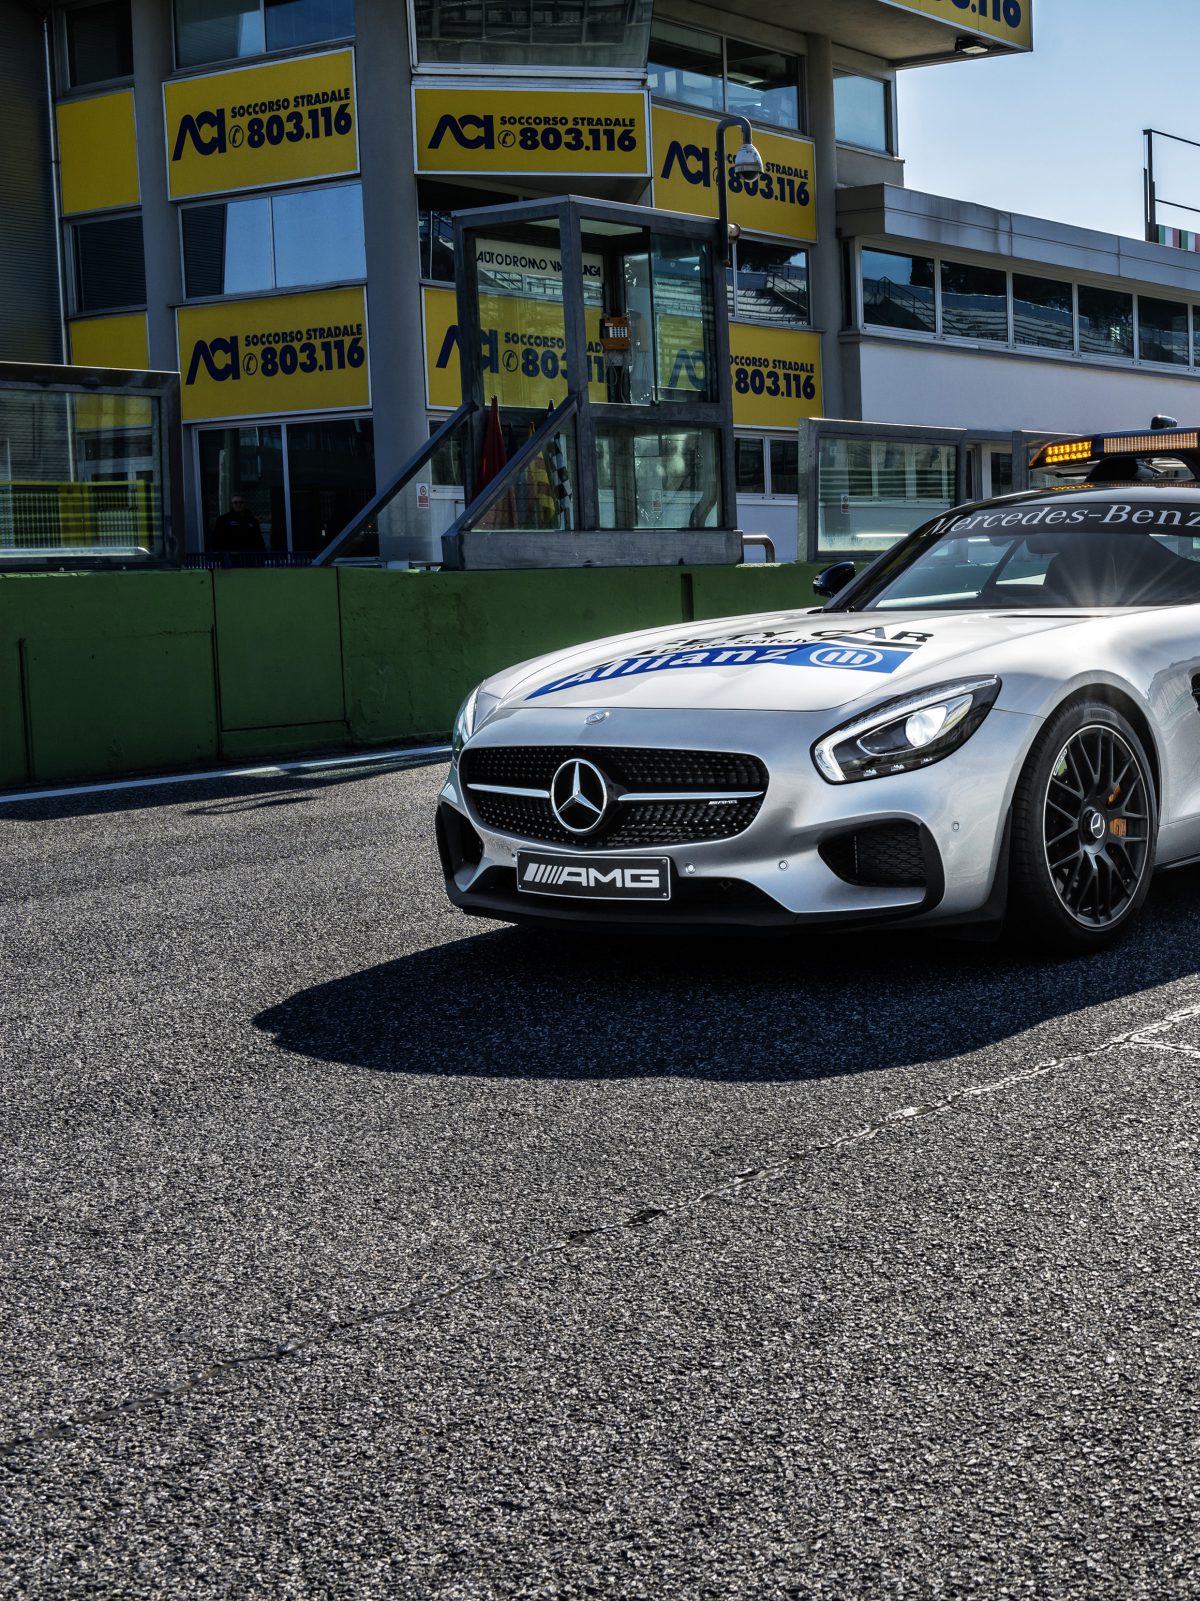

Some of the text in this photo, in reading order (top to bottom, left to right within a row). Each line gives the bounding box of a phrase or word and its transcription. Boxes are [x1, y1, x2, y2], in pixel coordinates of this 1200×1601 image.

[231, 88, 350, 118] SOCCORSO STRADALE
[172, 108, 227, 161] ACI
[247, 103, 352, 148] 803.116
[428, 114, 495, 149] ACI
[500, 116, 636, 127] SOCCORSO STRADALE
[519, 127, 637, 152] 803.116
[661, 140, 710, 187] ACI
[766, 162, 808, 180] STRADALE
[477, 251, 547, 270] AUTODROMO
[244, 323, 362, 347] SOCCORSO STRADALE
[504, 332, 564, 349] SOCCORSO
[185, 335, 241, 385] ACI
[260, 337, 365, 377] 803.116
[772, 359, 814, 373] STRADALE
[735, 367, 815, 400] 803.116
[811, 626, 934, 643] CAR
[549, 647, 798, 691] Allianz
